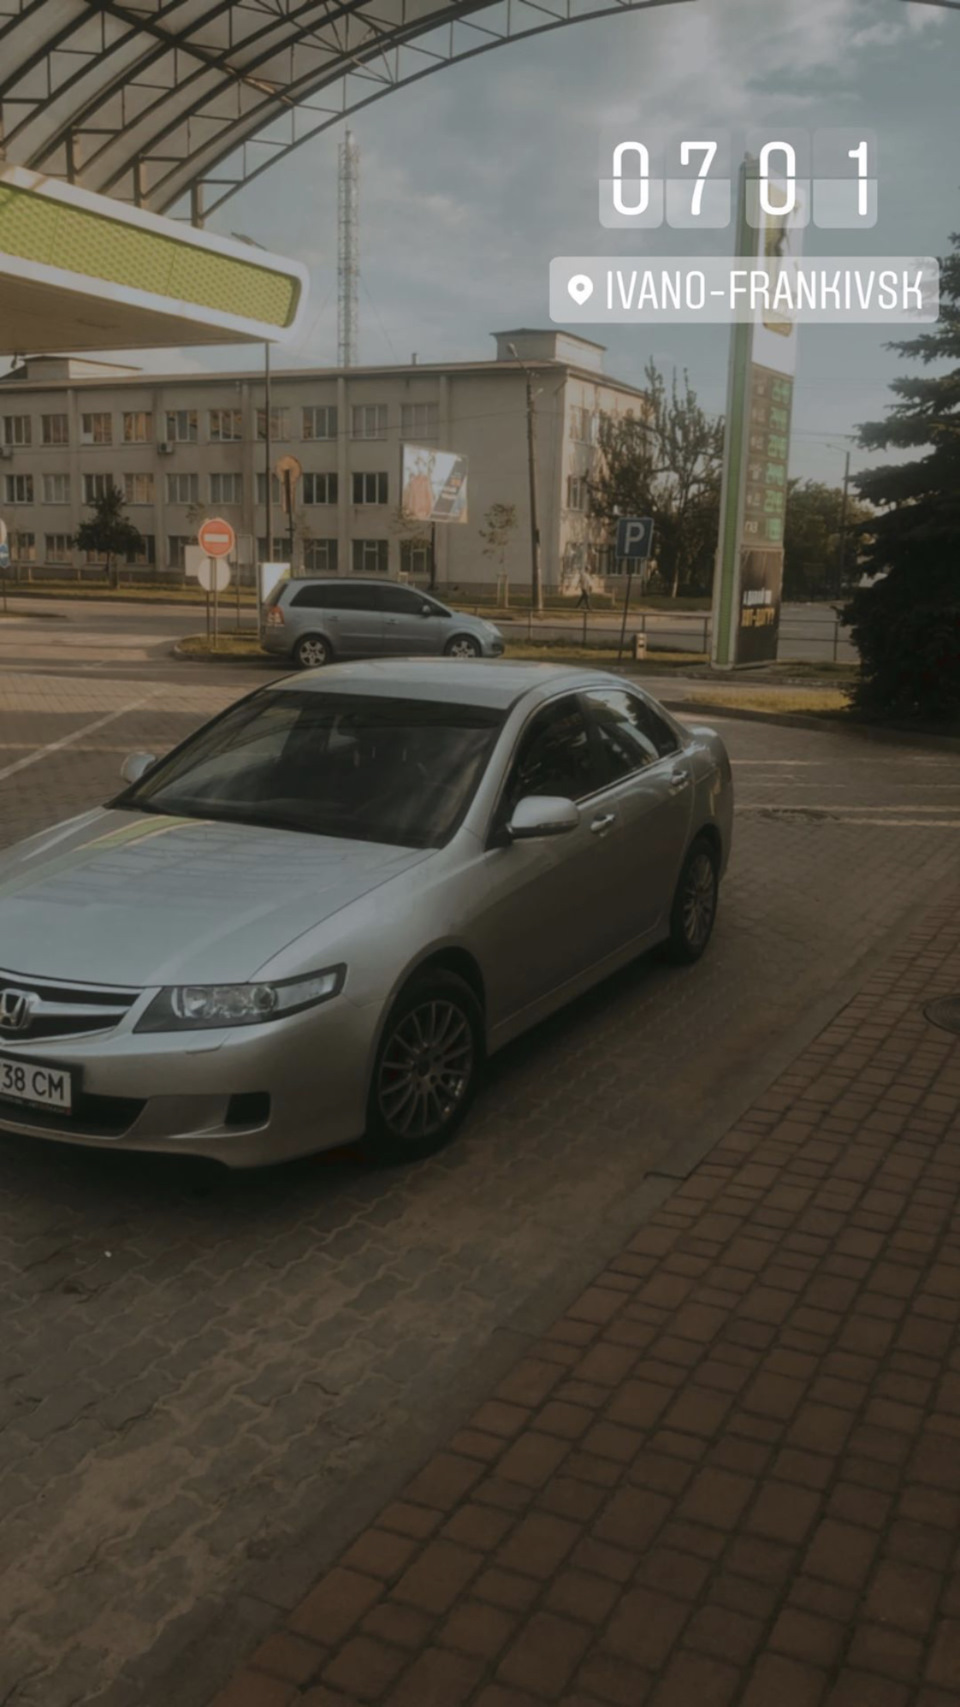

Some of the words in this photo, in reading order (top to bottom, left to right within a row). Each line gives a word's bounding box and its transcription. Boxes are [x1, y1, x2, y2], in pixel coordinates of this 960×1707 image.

[624, 521, 645, 555] P
[2, 1063, 26, 1092] 38
[32, 1070, 64, 1101] CM
